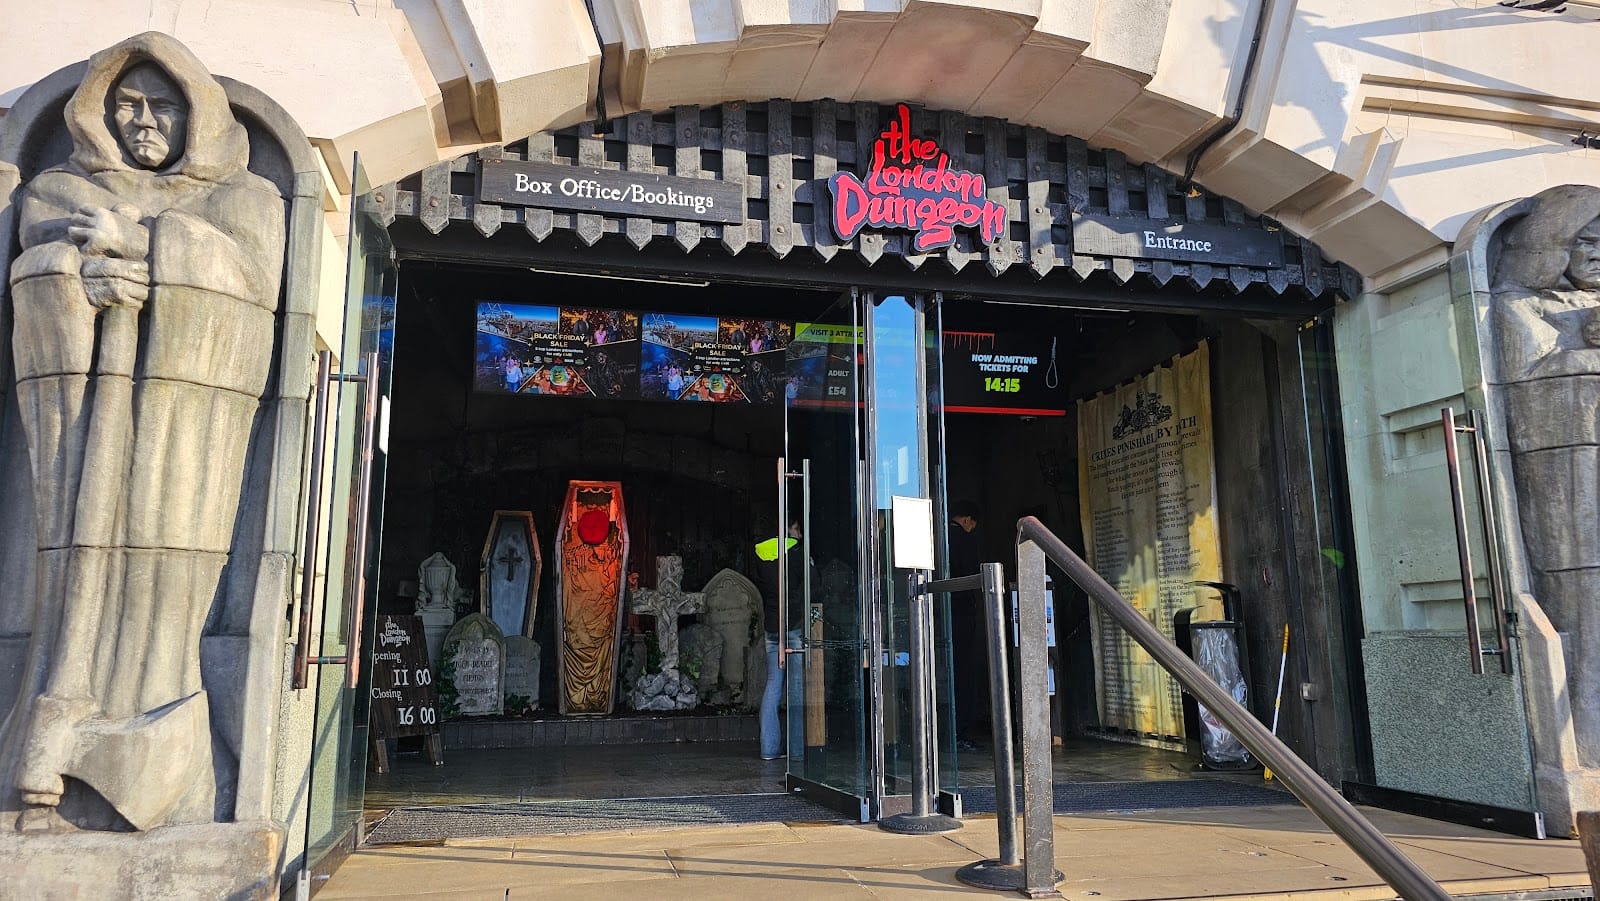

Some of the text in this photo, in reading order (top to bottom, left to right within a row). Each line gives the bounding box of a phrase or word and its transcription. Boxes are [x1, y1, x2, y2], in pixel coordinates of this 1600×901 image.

[881, 104, 940, 164] the
[868, 139, 983, 203] London
[515, 173, 714, 214] Box Office/Bookings
[836, 174, 1005, 249] Dungeon
[1143, 230, 1212, 252] Entrance
[534, 332, 585, 342] BLACK FRIDAY
[811, 328, 828, 336] VISIT
[717, 343, 742, 351] FRIDAY
[971, 354, 1038, 365] NOW ADMITTING
[979, 363, 1029, 373] TICKETS FOR
[828, 386, 847, 396] £54
[984, 377, 1021, 393] 14:15
[1117, 433, 1157, 455] PUNISHABL
[1157, 426, 1173, 439] BY
[385, 622, 407, 637] London
[379, 632, 411, 648] Dungeon
[416, 668, 431, 686] 00
[371, 687, 402, 701] Closing
[398, 706, 436, 725] 16 00
